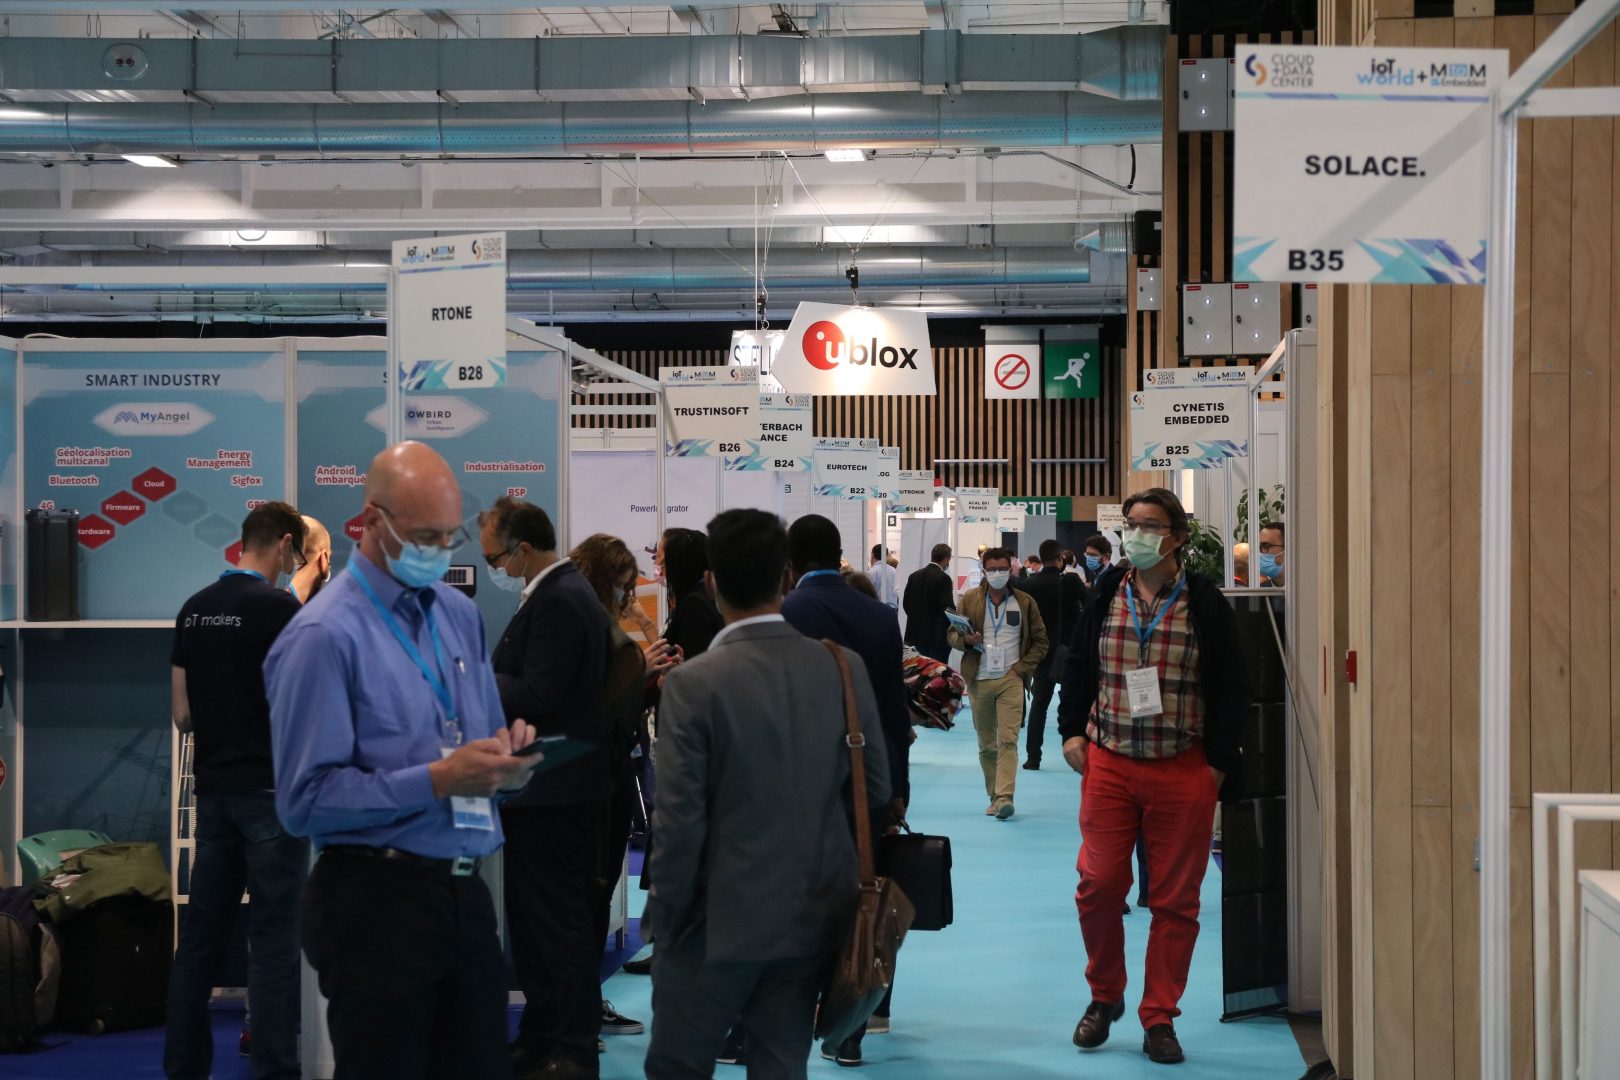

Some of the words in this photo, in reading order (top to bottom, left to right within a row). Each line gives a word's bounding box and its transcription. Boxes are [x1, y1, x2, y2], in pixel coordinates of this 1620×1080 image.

[1271, 54, 1314, 66] CLOUD
[1271, 76, 1314, 88] CENTER
[1305, 155, 1426, 177] SOLACE.
[1288, 249, 1344, 271] B35
[432, 306, 472, 321] RTONE
[459, 366, 483, 380] B28
[85, 374, 137, 387] SMART
[143, 374, 221, 387] INDUSTRY
[674, 406, 749, 416] TRUSTINSOFT
[1173, 402, 1225, 412] CYNETIS
[140, 411, 190, 424] MyAngel
[404, 410, 452, 419] OWBIRD
[1164, 415, 1229, 425] EMBEDDED
[759, 422, 802, 432] ERBACH
[57, 447, 131, 458] Géolocalisation
[719, 442, 740, 453] B26
[1166, 445, 1189, 455] B25
[218, 450, 251, 461] Energy
[57, 457, 108, 466] multicanal
[188, 458, 251, 469] Management
[465, 462, 545, 471] Industrialisation
[774, 458, 794, 468] B24
[1150, 458, 1171, 467] B23
[316, 466, 356, 476] Android
[50, 476, 98, 486] Bluetooth
[144, 480, 165, 488] Cloud
[232, 476, 262, 487] Sigfox
[508, 488, 526, 497] BSP
[41, 501, 53, 510] 4G
[201, 612, 242, 627] makers
